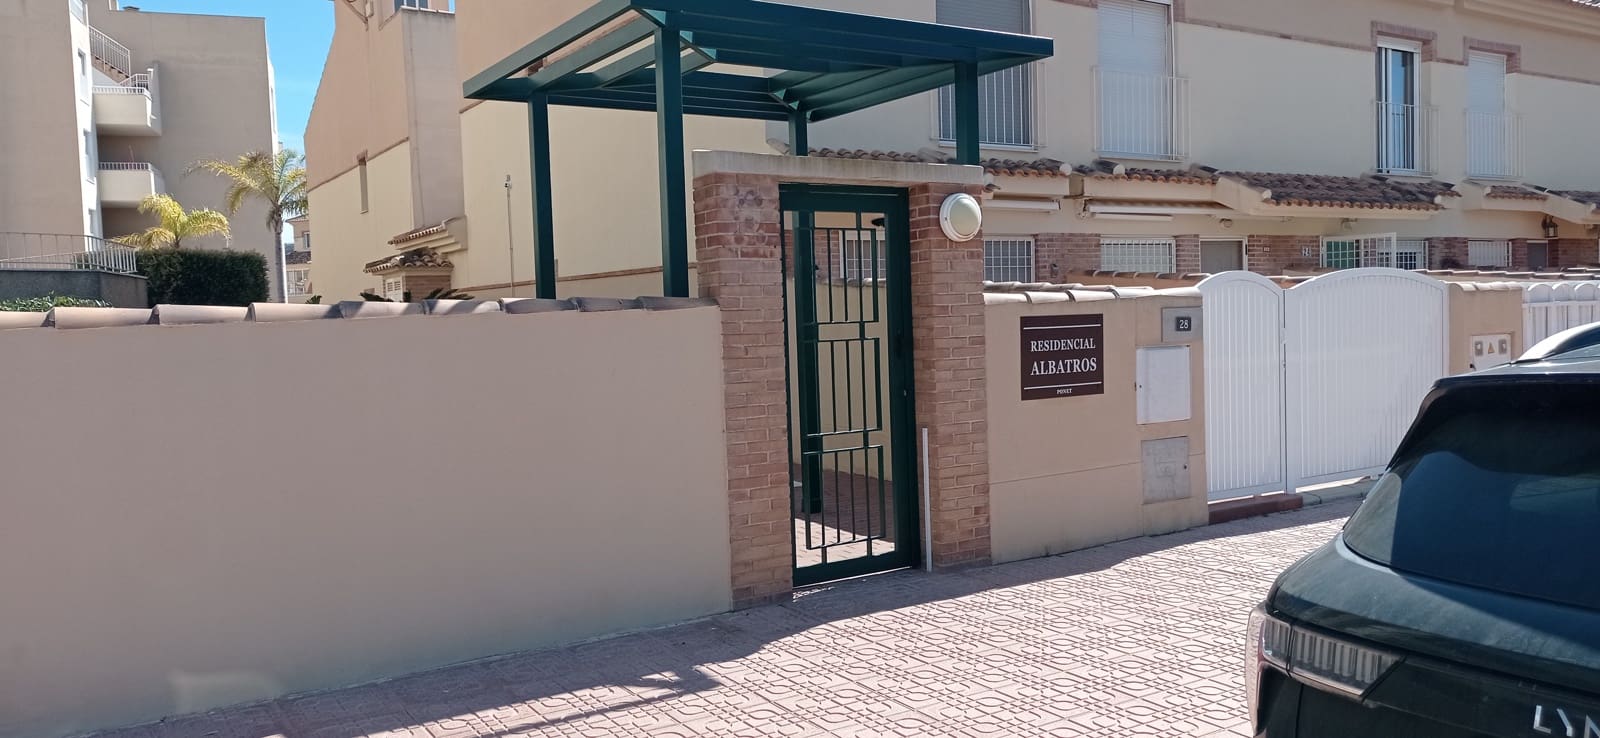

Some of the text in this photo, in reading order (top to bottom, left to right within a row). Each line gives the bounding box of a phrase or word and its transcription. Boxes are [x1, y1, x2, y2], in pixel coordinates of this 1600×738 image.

[1179, 319, 1189, 329] 28
[1030, 338, 1096, 352] RESIDENCIAL
[1030, 357, 1097, 376] ALBATROS
